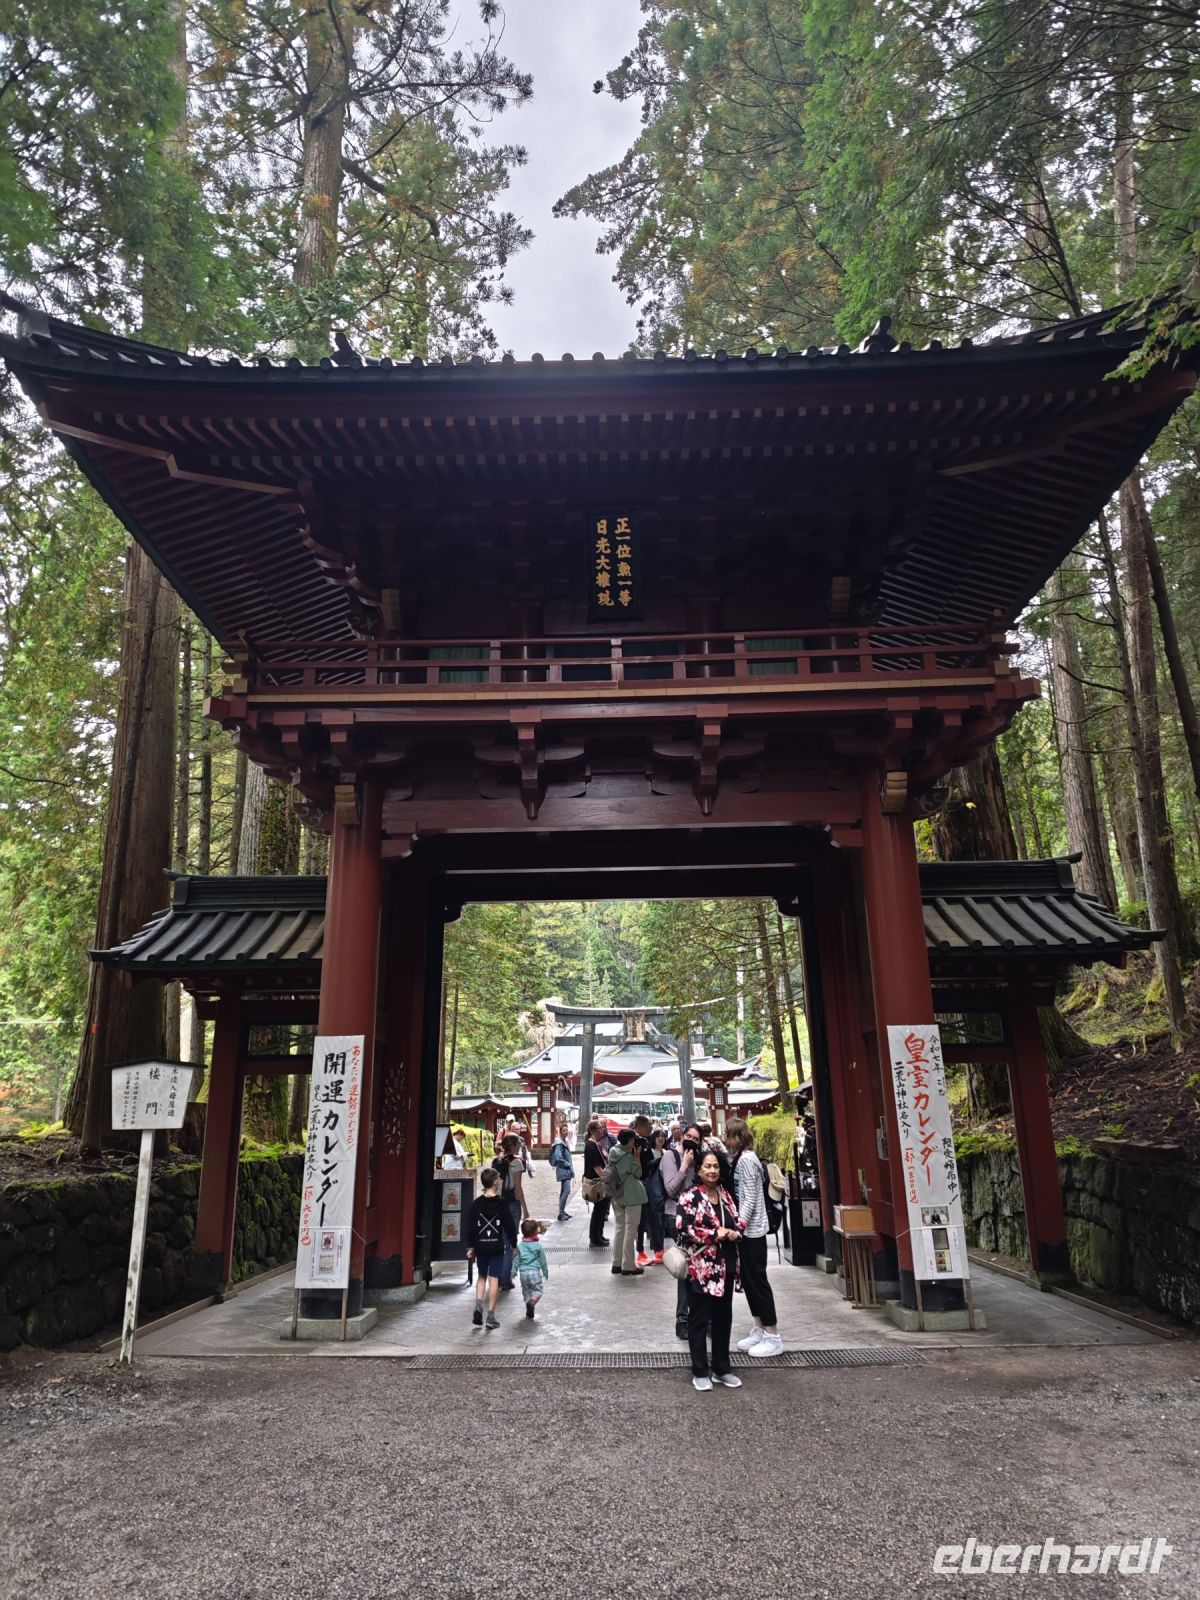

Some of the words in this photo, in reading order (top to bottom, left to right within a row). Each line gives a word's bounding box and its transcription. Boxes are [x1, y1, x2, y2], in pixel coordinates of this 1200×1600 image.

[315, 1052, 347, 1228] 開運カレンダー
[903, 1031, 938, 1188] 皇室カレンダー
